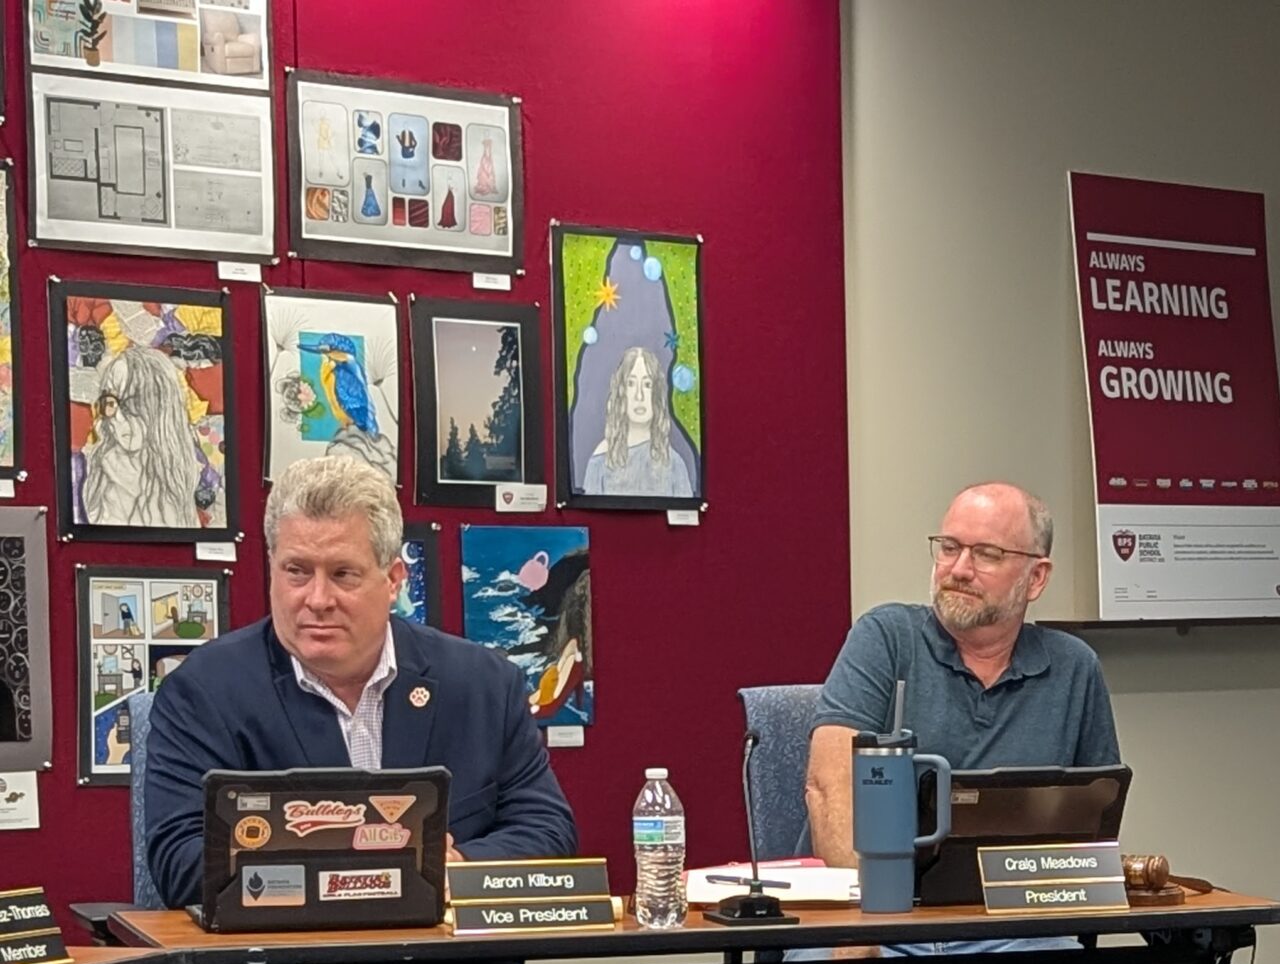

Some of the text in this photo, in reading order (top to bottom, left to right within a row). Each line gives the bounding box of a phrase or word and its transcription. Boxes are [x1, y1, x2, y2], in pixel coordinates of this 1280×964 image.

[1089, 251, 1145, 272] ALWAYS
[1090, 276, 1229, 319] LEARNING
[1098, 339, 1154, 360] ALWAYS
[1100, 365, 1233, 404] GROWING
[287, 804, 362, 820] Bulldogs
[1005, 855, 1098, 872] Craig Meadows
[482, 873, 574, 889] Aaron Kilburg
[1025, 889, 1087, 903] President
[482, 906, 588, 924] Vice President
[0, 944, 48, 961] Member
